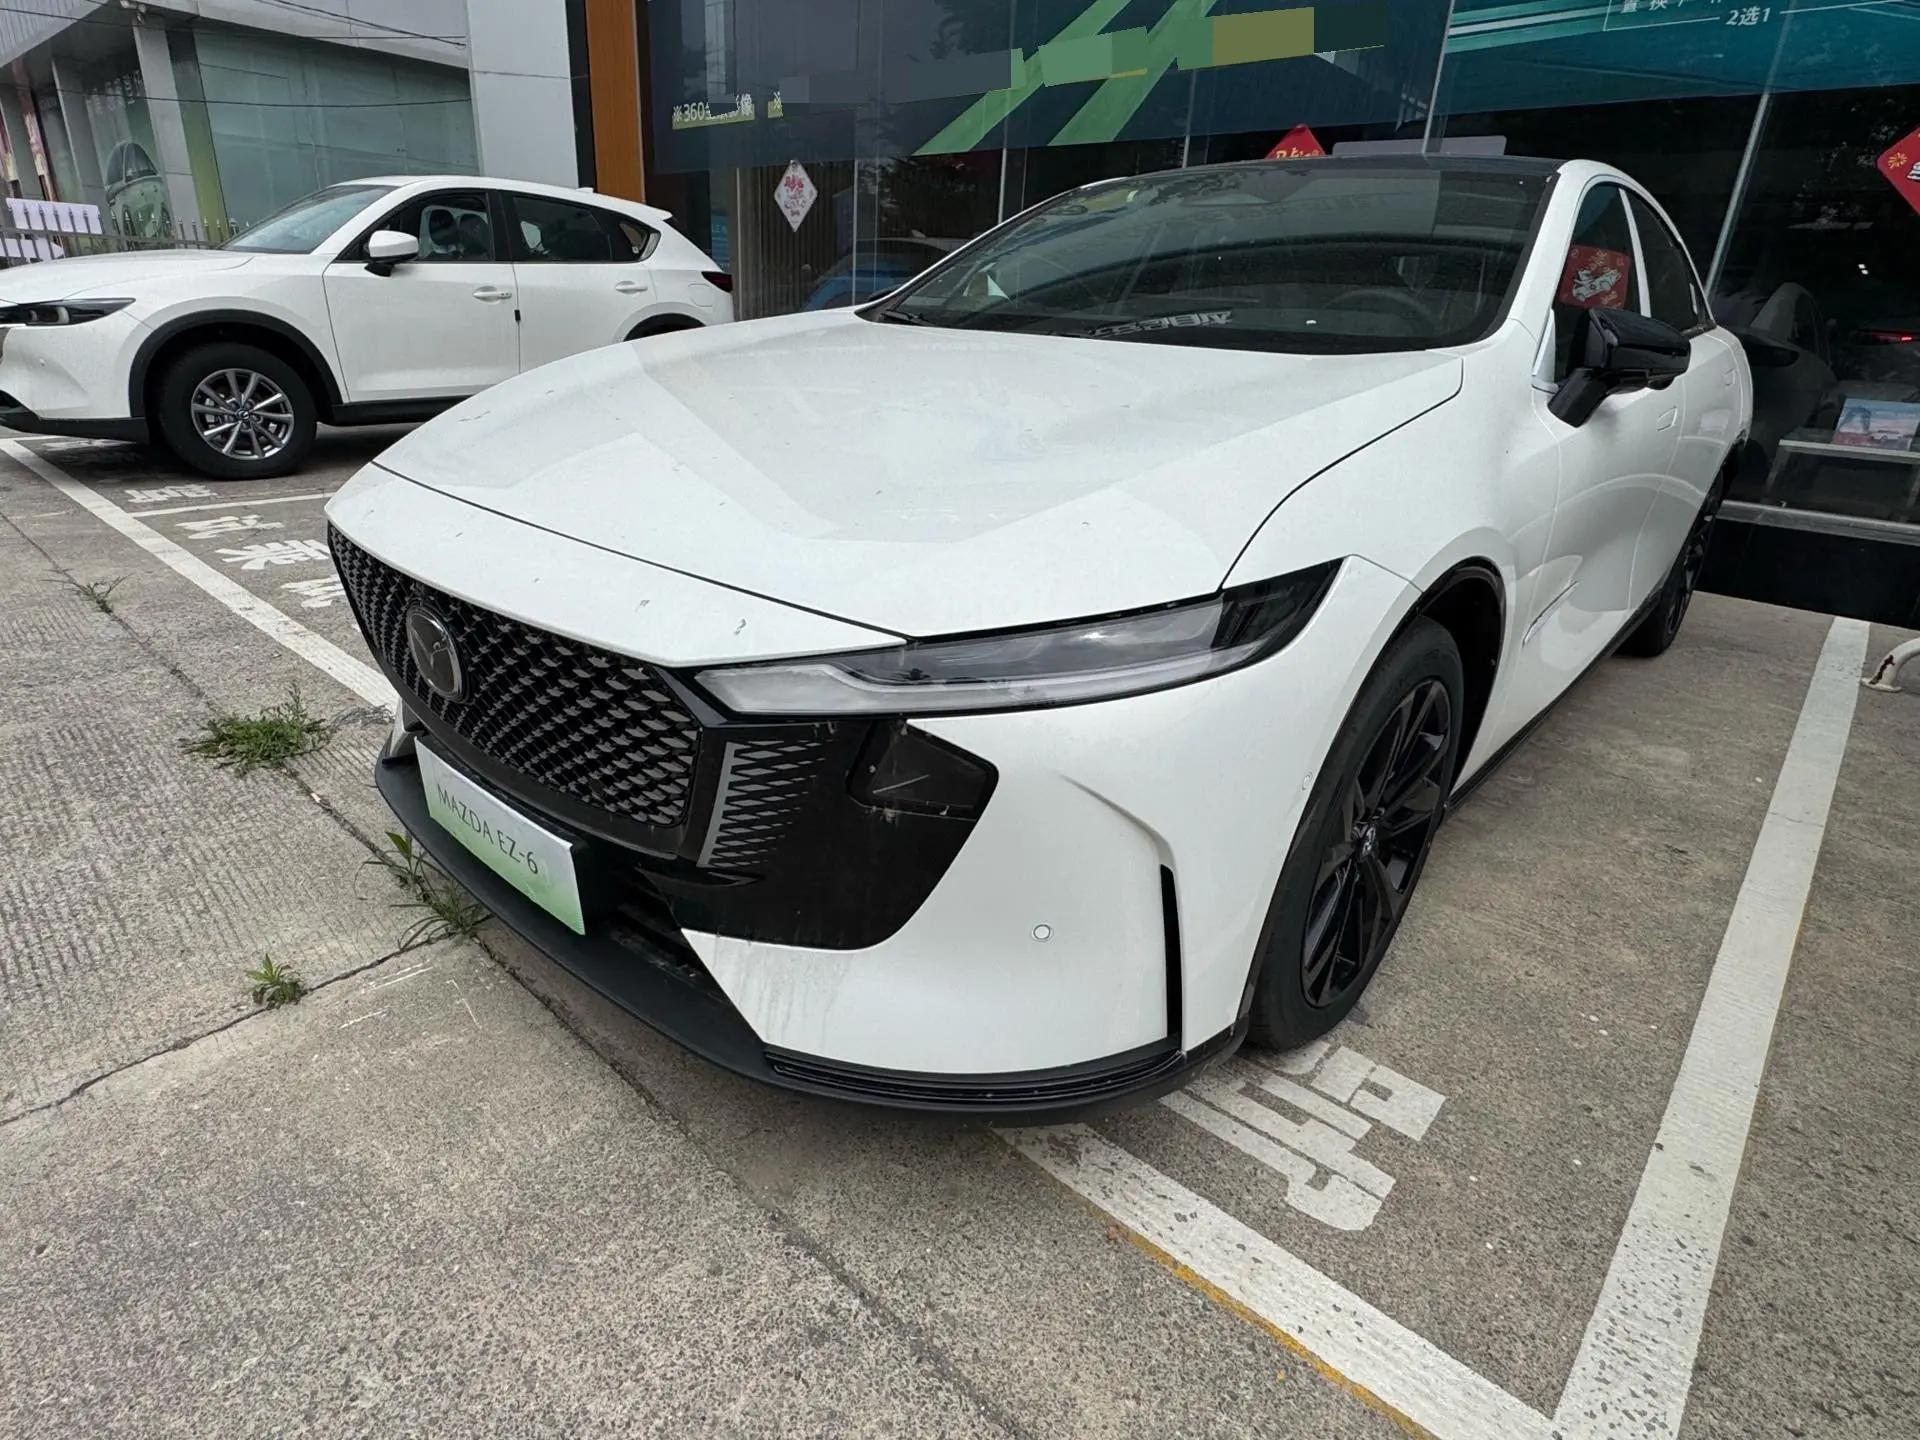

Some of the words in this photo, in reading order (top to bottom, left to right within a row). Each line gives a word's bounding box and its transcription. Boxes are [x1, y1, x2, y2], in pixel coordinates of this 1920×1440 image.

[1726, 7, 1771, 27] 2选1
[437, 783, 494, 845] MAZDA
[497, 830, 539, 875] EZ-6
